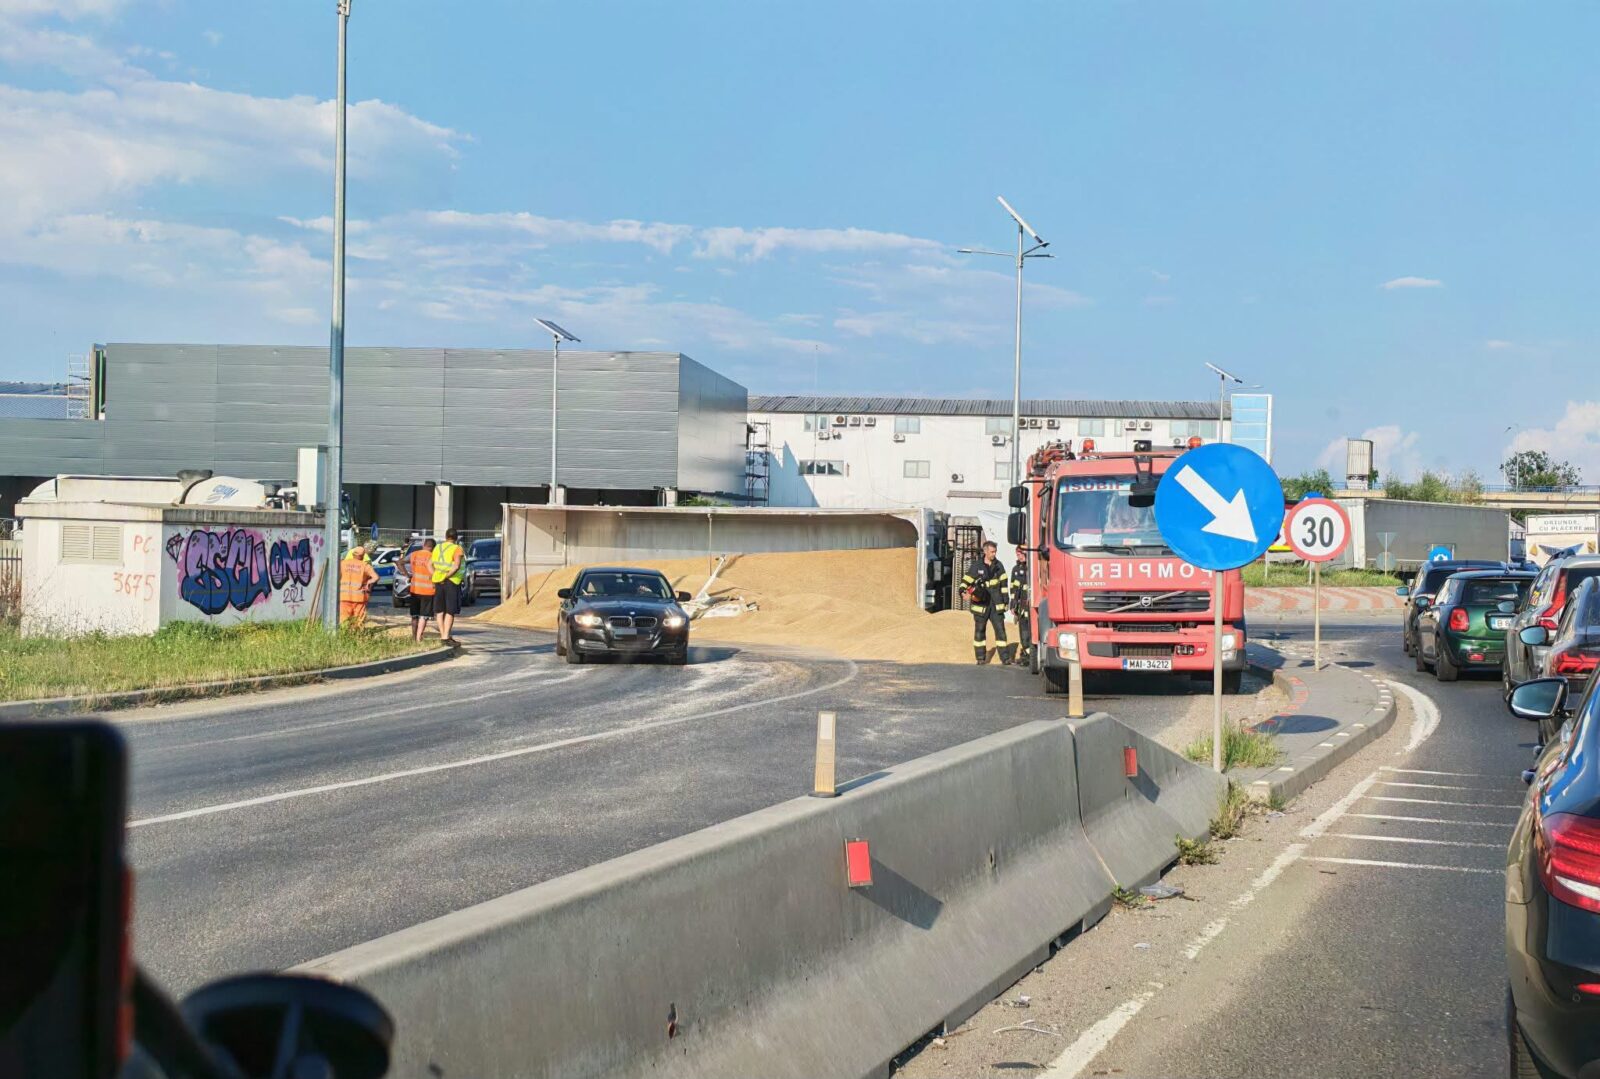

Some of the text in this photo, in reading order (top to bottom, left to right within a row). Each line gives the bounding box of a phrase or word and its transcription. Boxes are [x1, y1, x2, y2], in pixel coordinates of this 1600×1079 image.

[1301, 516, 1334, 548] 30
[113, 571, 155, 602] 3675
[1129, 660, 1169, 669] MAI 34212
